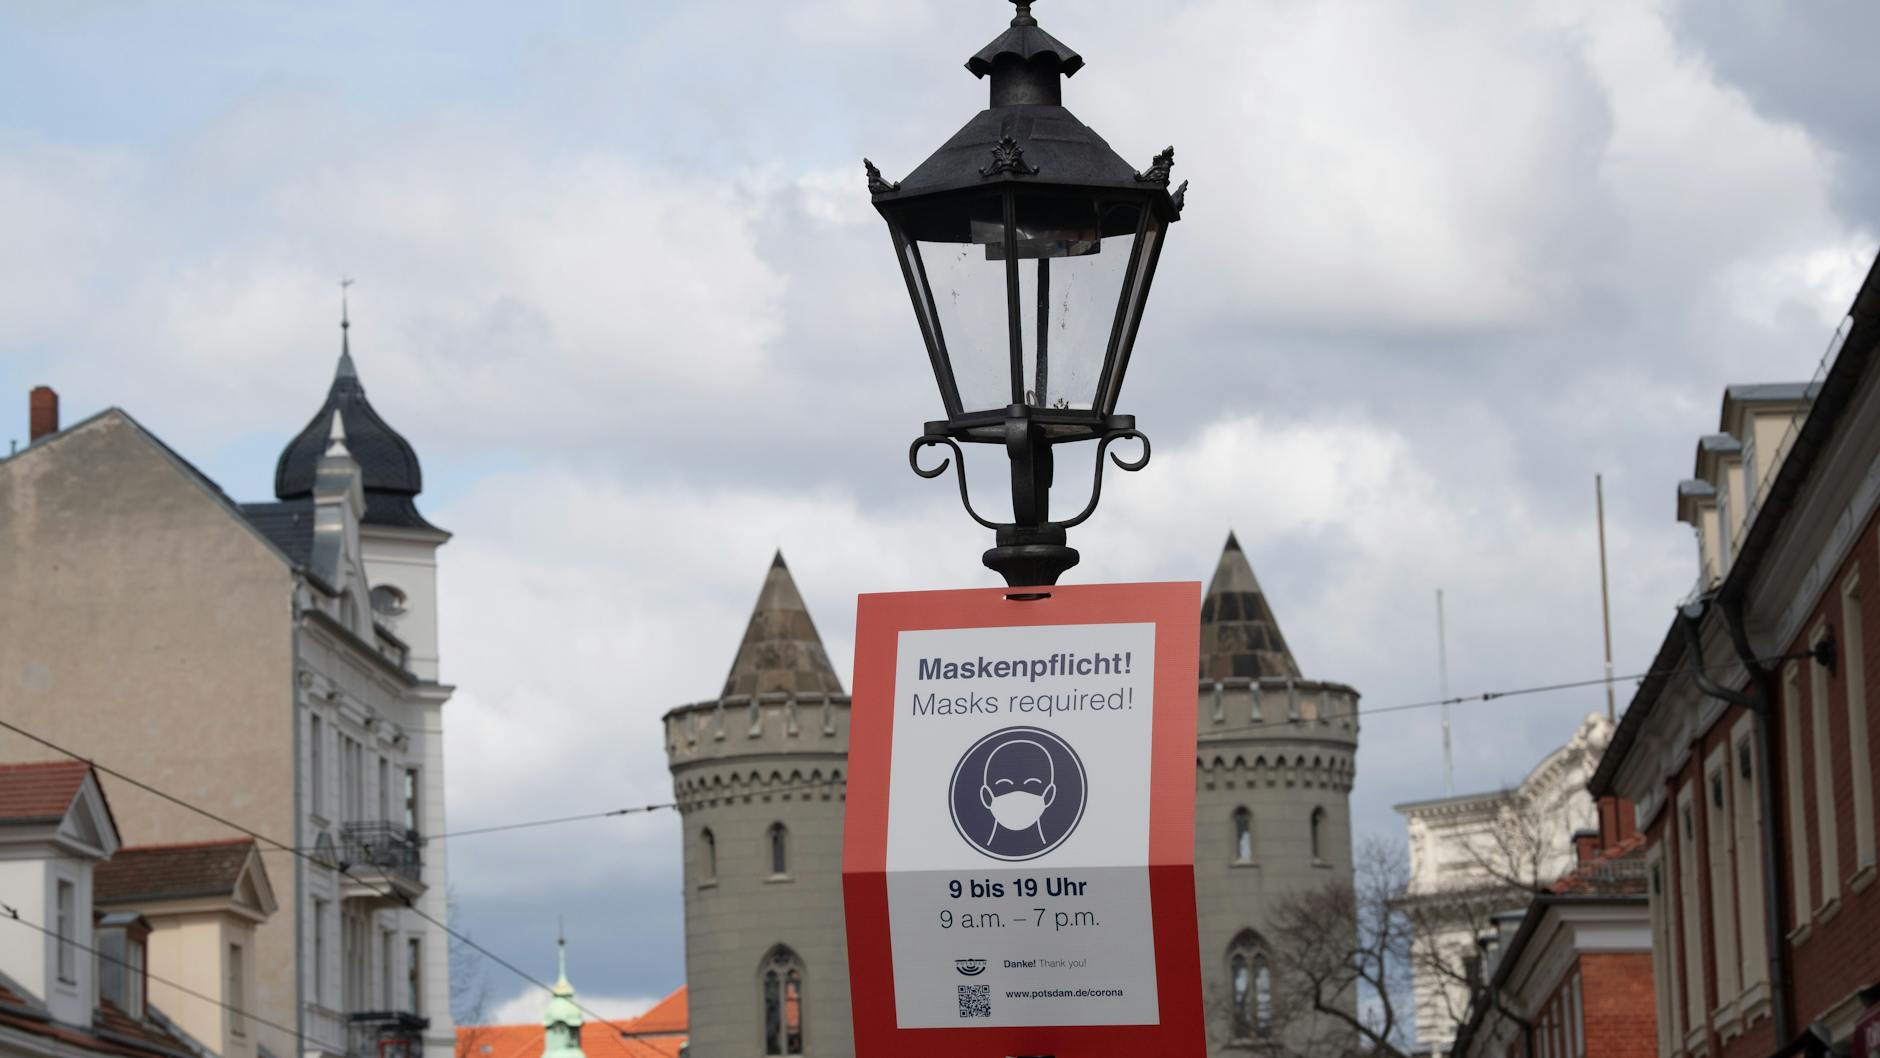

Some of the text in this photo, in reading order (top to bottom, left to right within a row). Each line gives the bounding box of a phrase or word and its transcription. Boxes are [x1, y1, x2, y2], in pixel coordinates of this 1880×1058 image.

[918, 652, 1132, 683] Maskenpflicht!
[913, 687, 1133, 718] Masks required!
[949, 876, 1088, 899] 9 bis 19 Uhr
[939, 909, 953, 929] 9
[961, 912, 1006, 929] a.m.
[1033, 907, 1046, 927] 7
[1055, 911, 1100, 932] p.m.
[1003, 958, 1087, 970] Danke! Thank you!
[1005, 988, 1124, 1000] www.potsdam.de/corona
